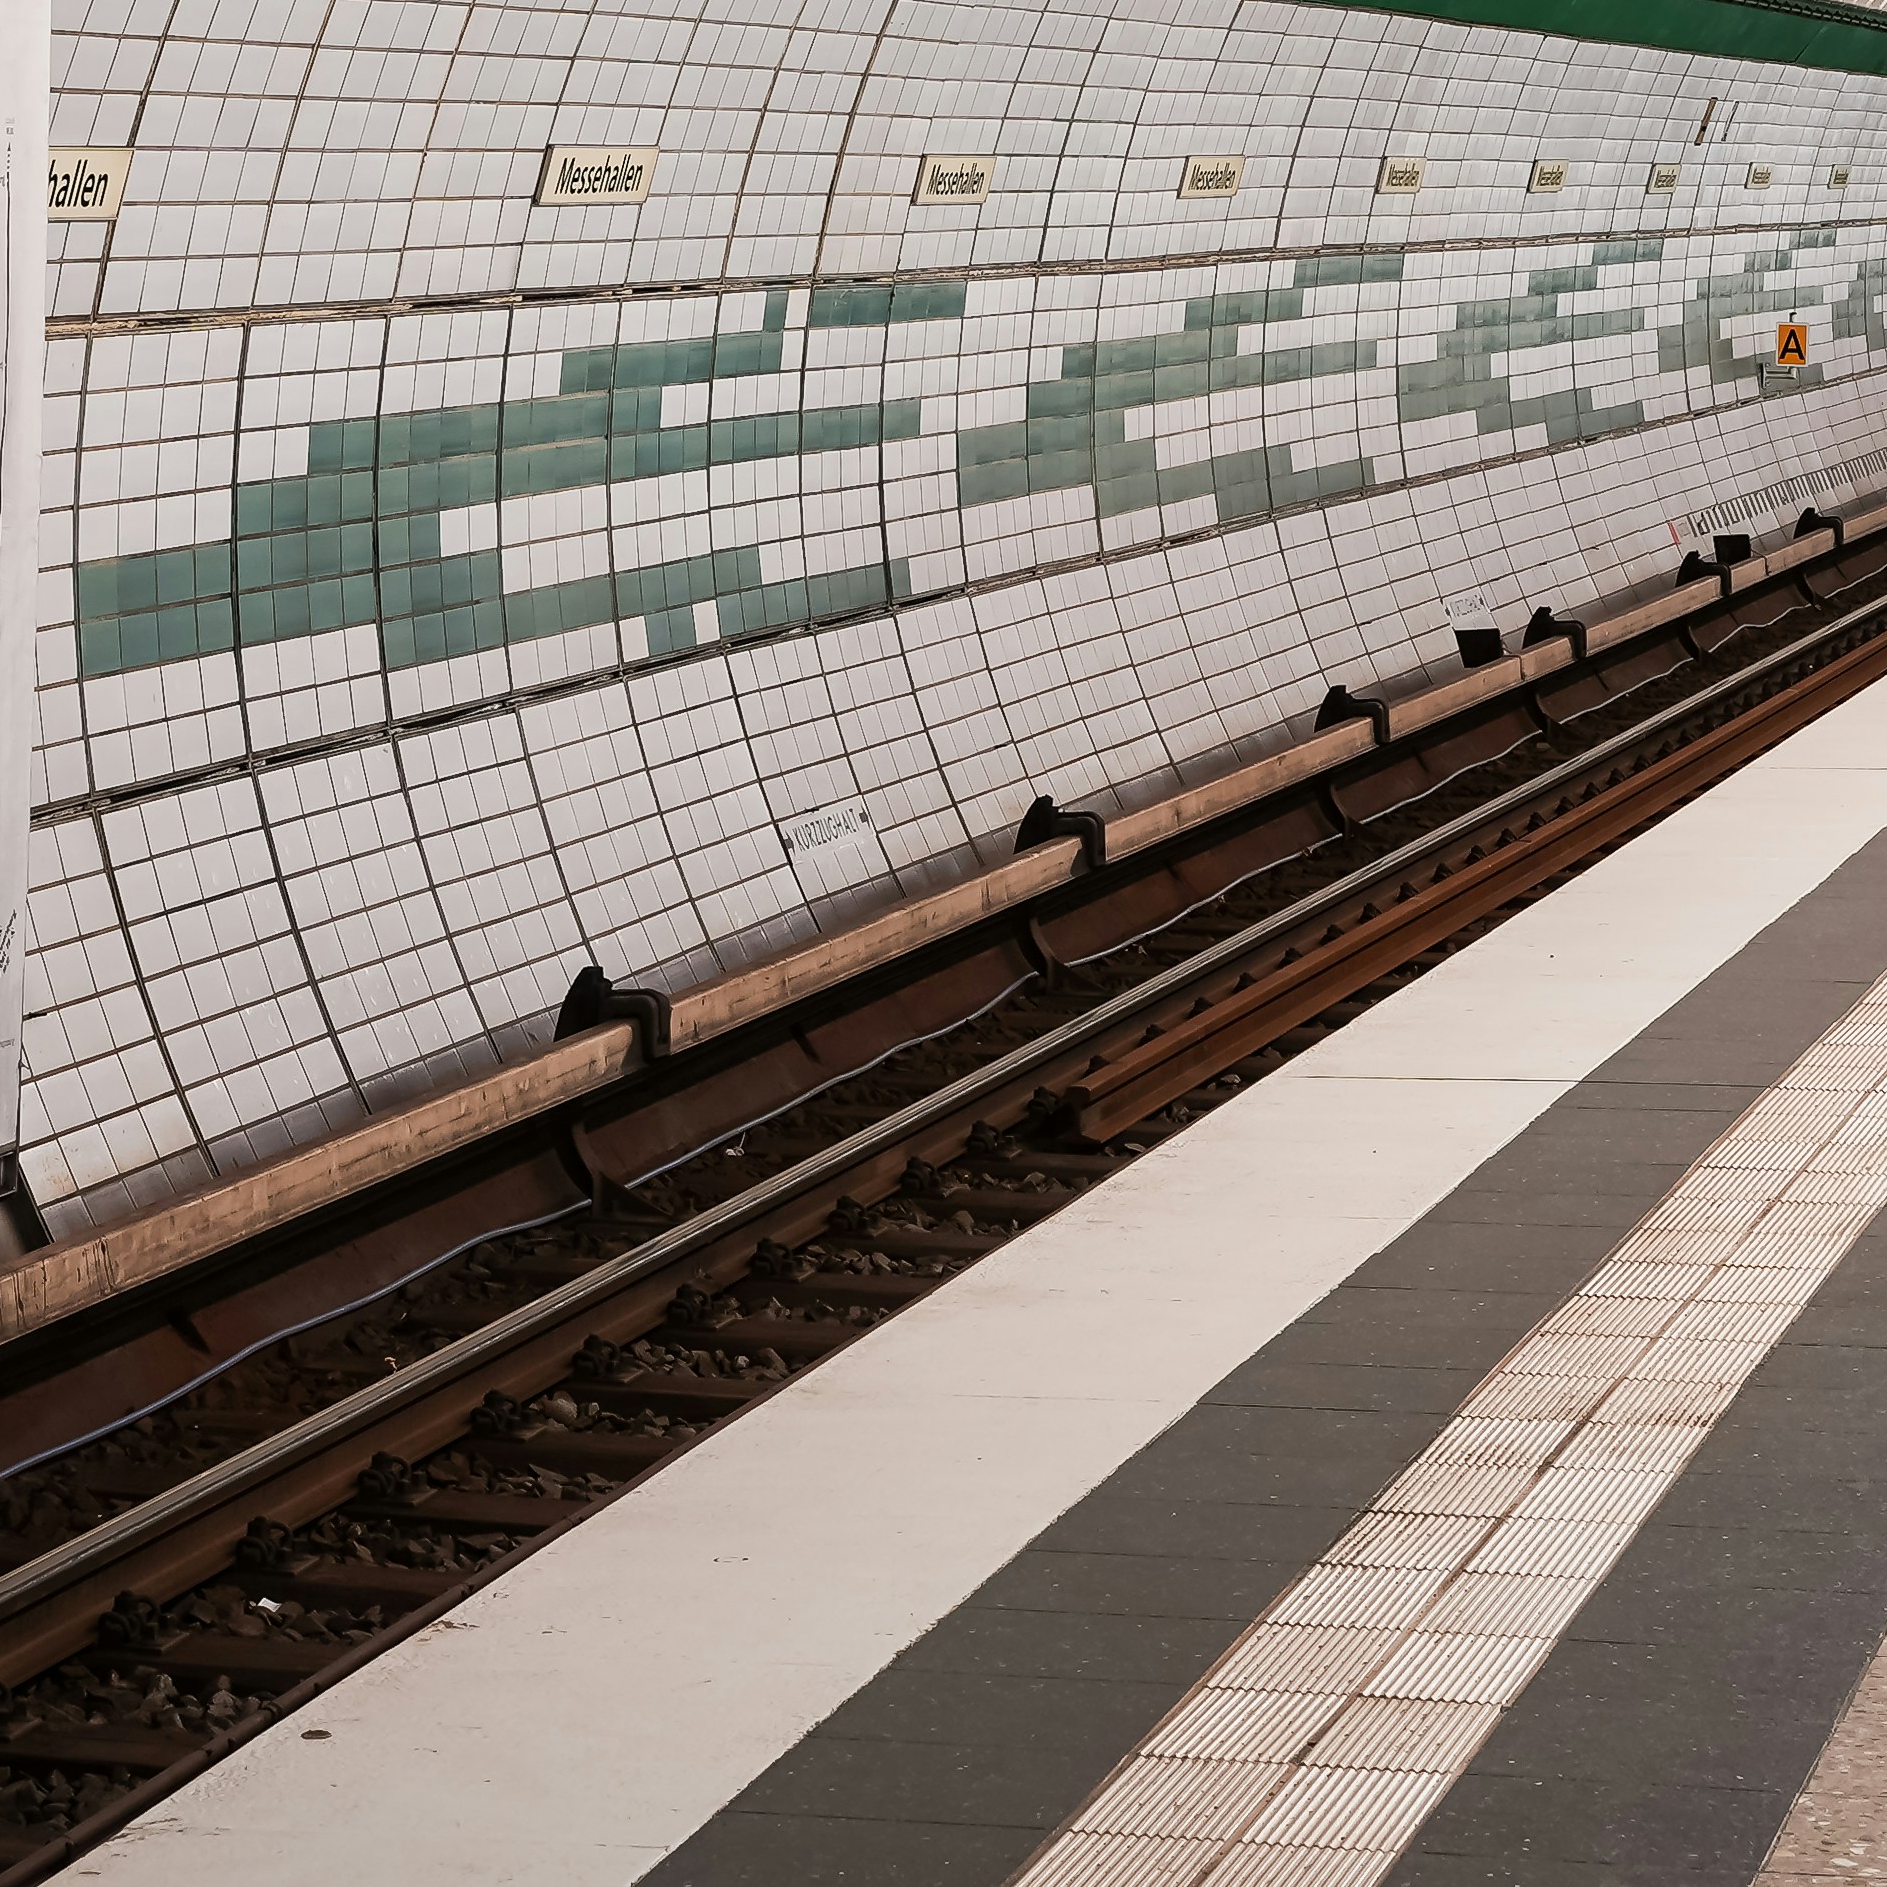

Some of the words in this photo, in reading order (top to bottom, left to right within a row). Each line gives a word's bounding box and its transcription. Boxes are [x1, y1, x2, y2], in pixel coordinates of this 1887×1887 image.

[554, 154, 644, 196] Messehallen
[926, 163, 986, 196] Messehallen
[1779, 328, 1806, 360] A
[791, 808, 860, 853] KURZZUGHALT
